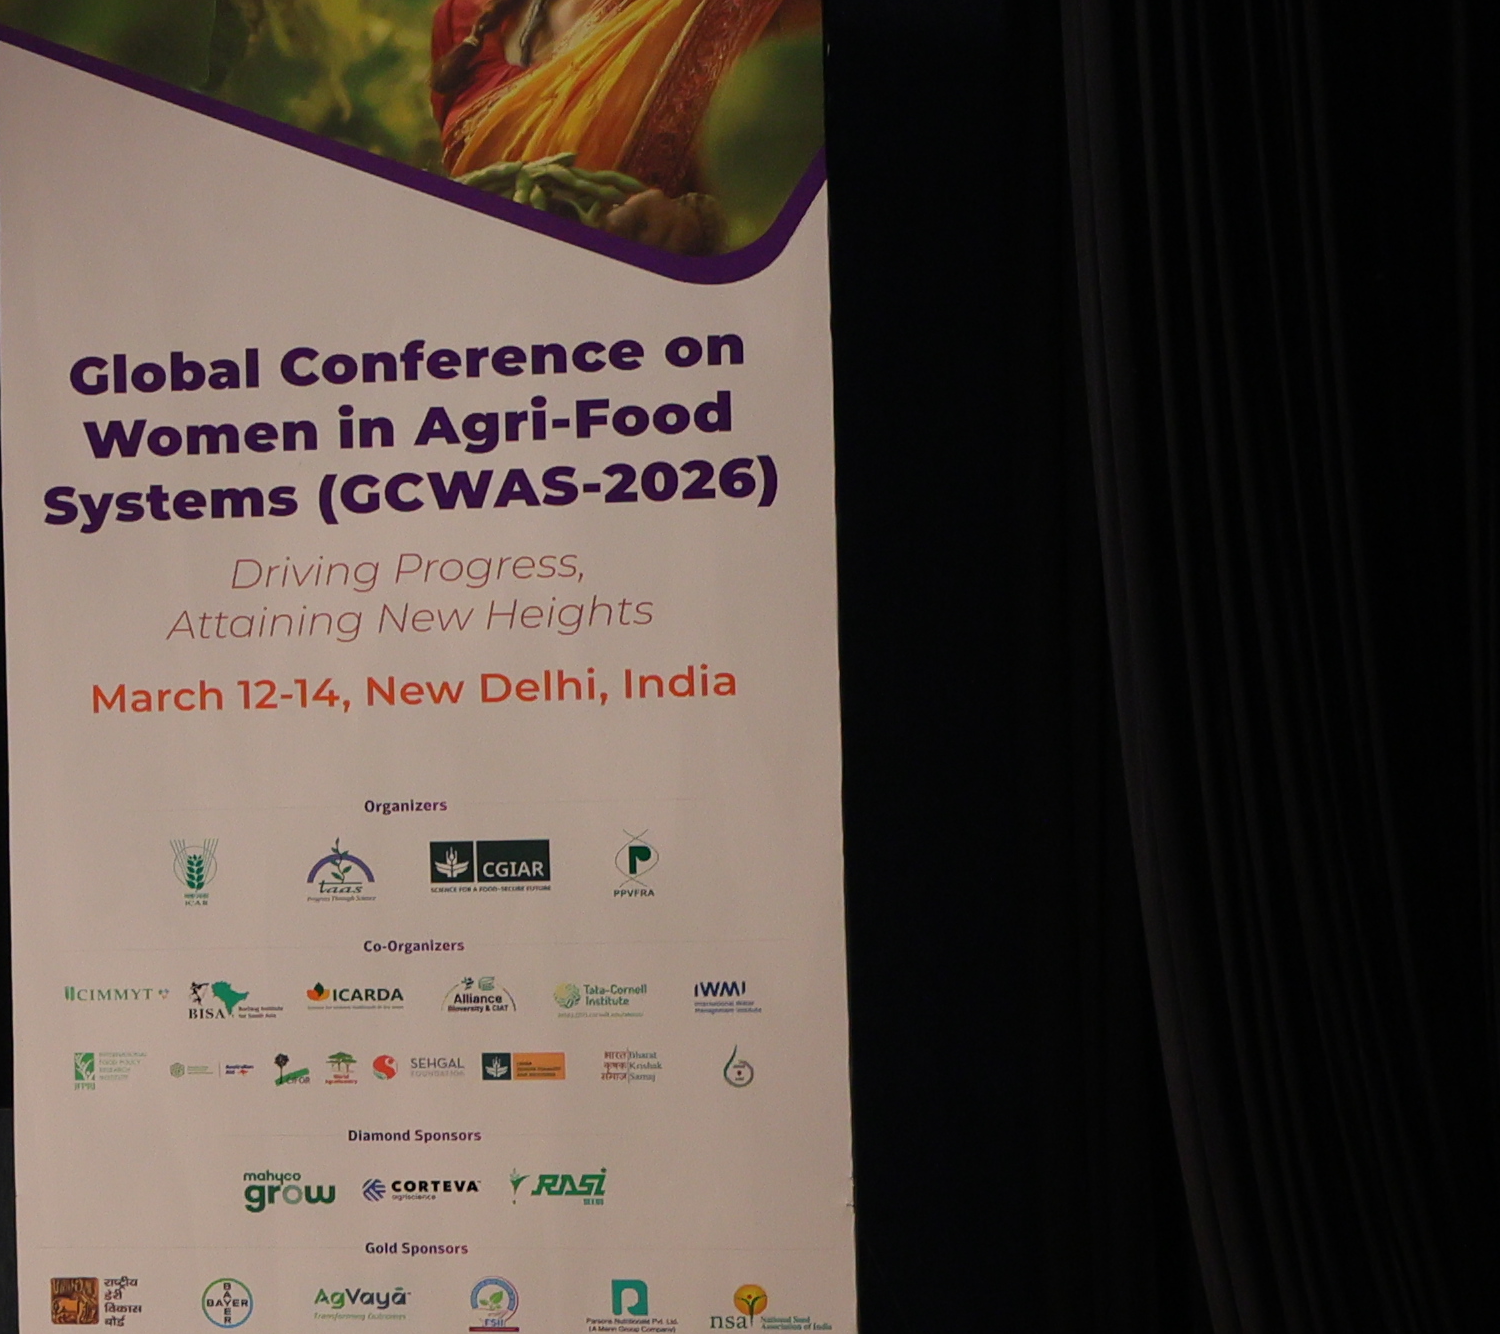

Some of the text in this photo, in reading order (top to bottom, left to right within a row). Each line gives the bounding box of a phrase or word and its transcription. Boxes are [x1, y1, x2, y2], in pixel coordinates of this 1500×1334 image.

[69, 333, 745, 396] Global Conference on
[82, 389, 732, 460] Women in Agri-Food
[43, 454, 778, 535] Systems (GCWAS-2026)
[231, 553, 584, 593] Driving Progress,
[165, 594, 654, 643] Attaining New Heights
[92, 662, 737, 714] March 12-14, New Delhi, India
[364, 798, 448, 816] Organizers
[482, 861, 544, 879] CGIAR
[319, 879, 363, 894] taas
[613, 888, 655, 898] PPVFRA
[363, 939, 465, 955] Co-Organizers
[77, 988, 154, 1002] CIMMYT
[333, 988, 404, 1002] ICARDA
[584, 984, 647, 996] Tata-Cornell
[695, 981, 746, 997] IWMI
[454, 994, 502, 1004] Alliance
[585, 995, 630, 1006] Institute
[188, 1008, 226, 1020] BISA
[410, 1057, 466, 1069] SEHGAL
[348, 1129, 482, 1144] Diamond Sponsors
[243, 1170, 301, 1183] mahyco
[391, 1180, 478, 1193] CORTEVA
[244, 1184, 336, 1212] grow
[365, 1241, 469, 1257] Gold Sponsors
[206, 1299, 248, 1307] BAYER
